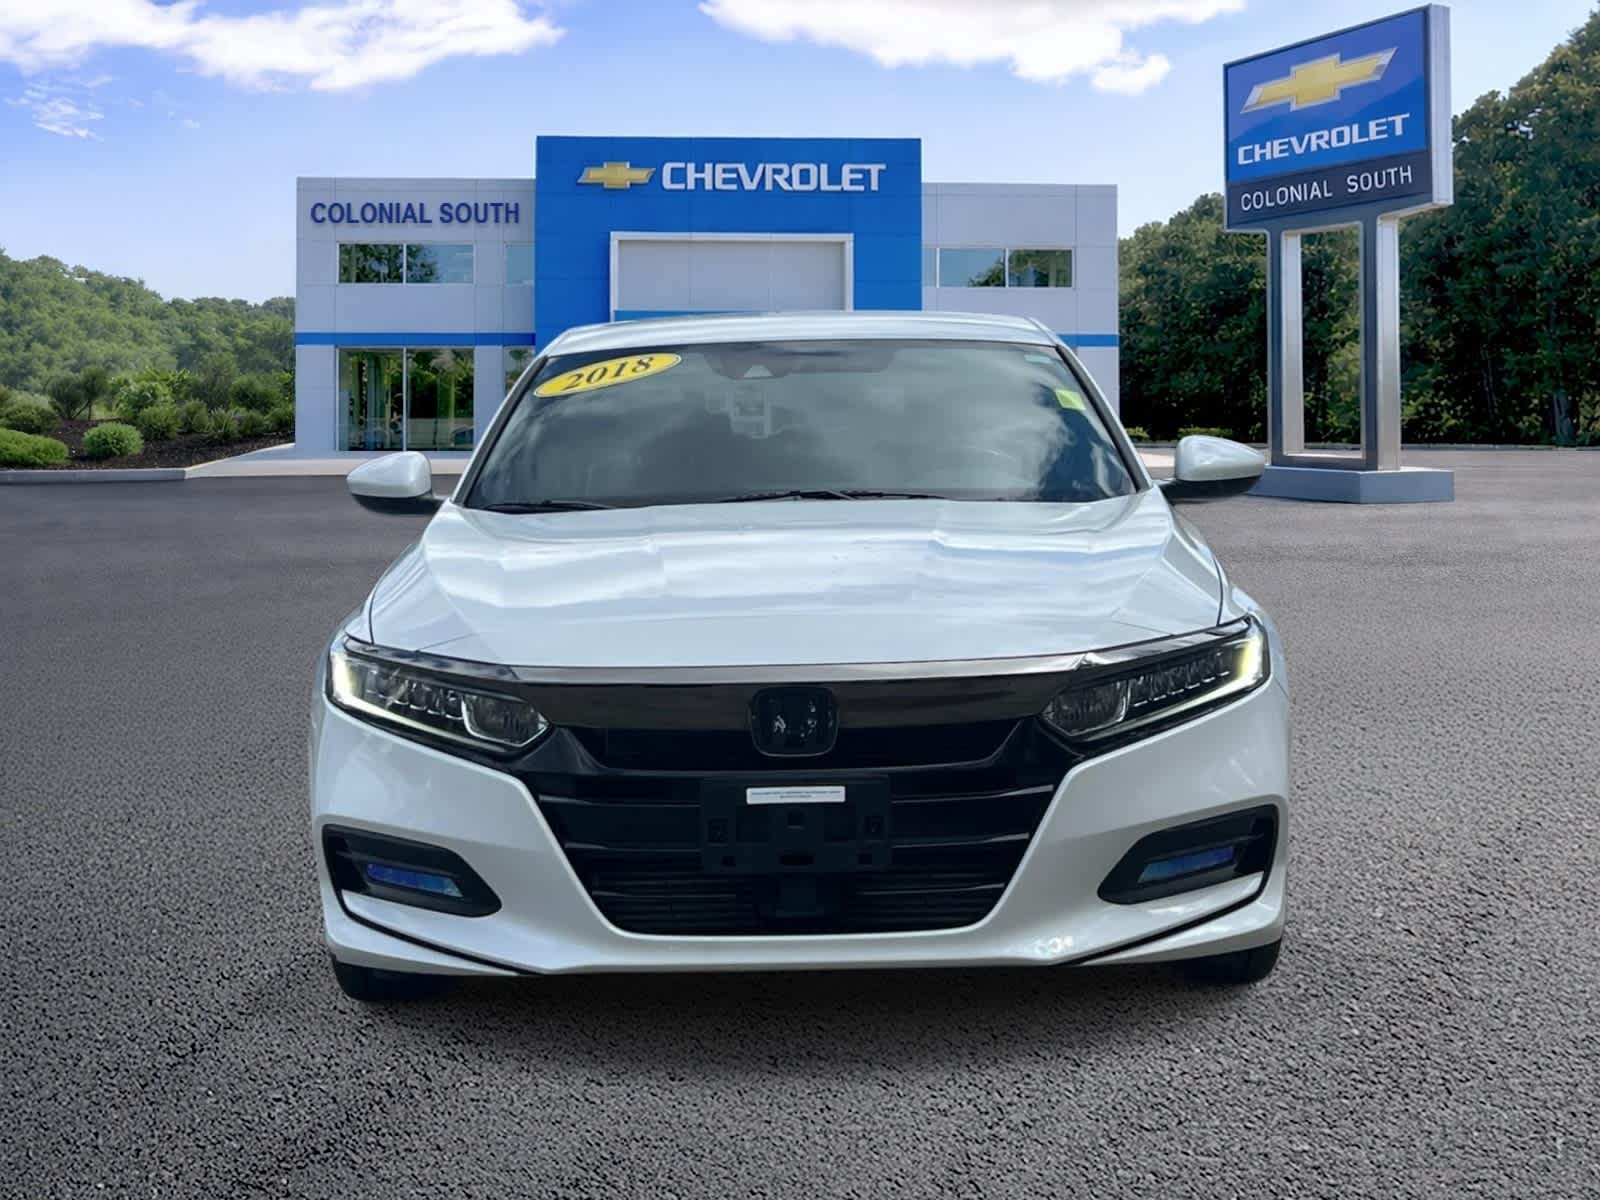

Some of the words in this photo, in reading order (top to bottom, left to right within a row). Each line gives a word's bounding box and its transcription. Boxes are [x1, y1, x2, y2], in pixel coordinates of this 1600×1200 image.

[1238, 113, 1410, 165] CHEVROLET
[661, 162, 887, 192] CHEVROLET
[1240, 179, 1333, 211] COLONIAL
[1346, 165, 1413, 193] SOUTH
[310, 202, 433, 225] COLONIAL
[438, 202, 521, 225] SOUTH
[562, 356, 654, 391] 2018
